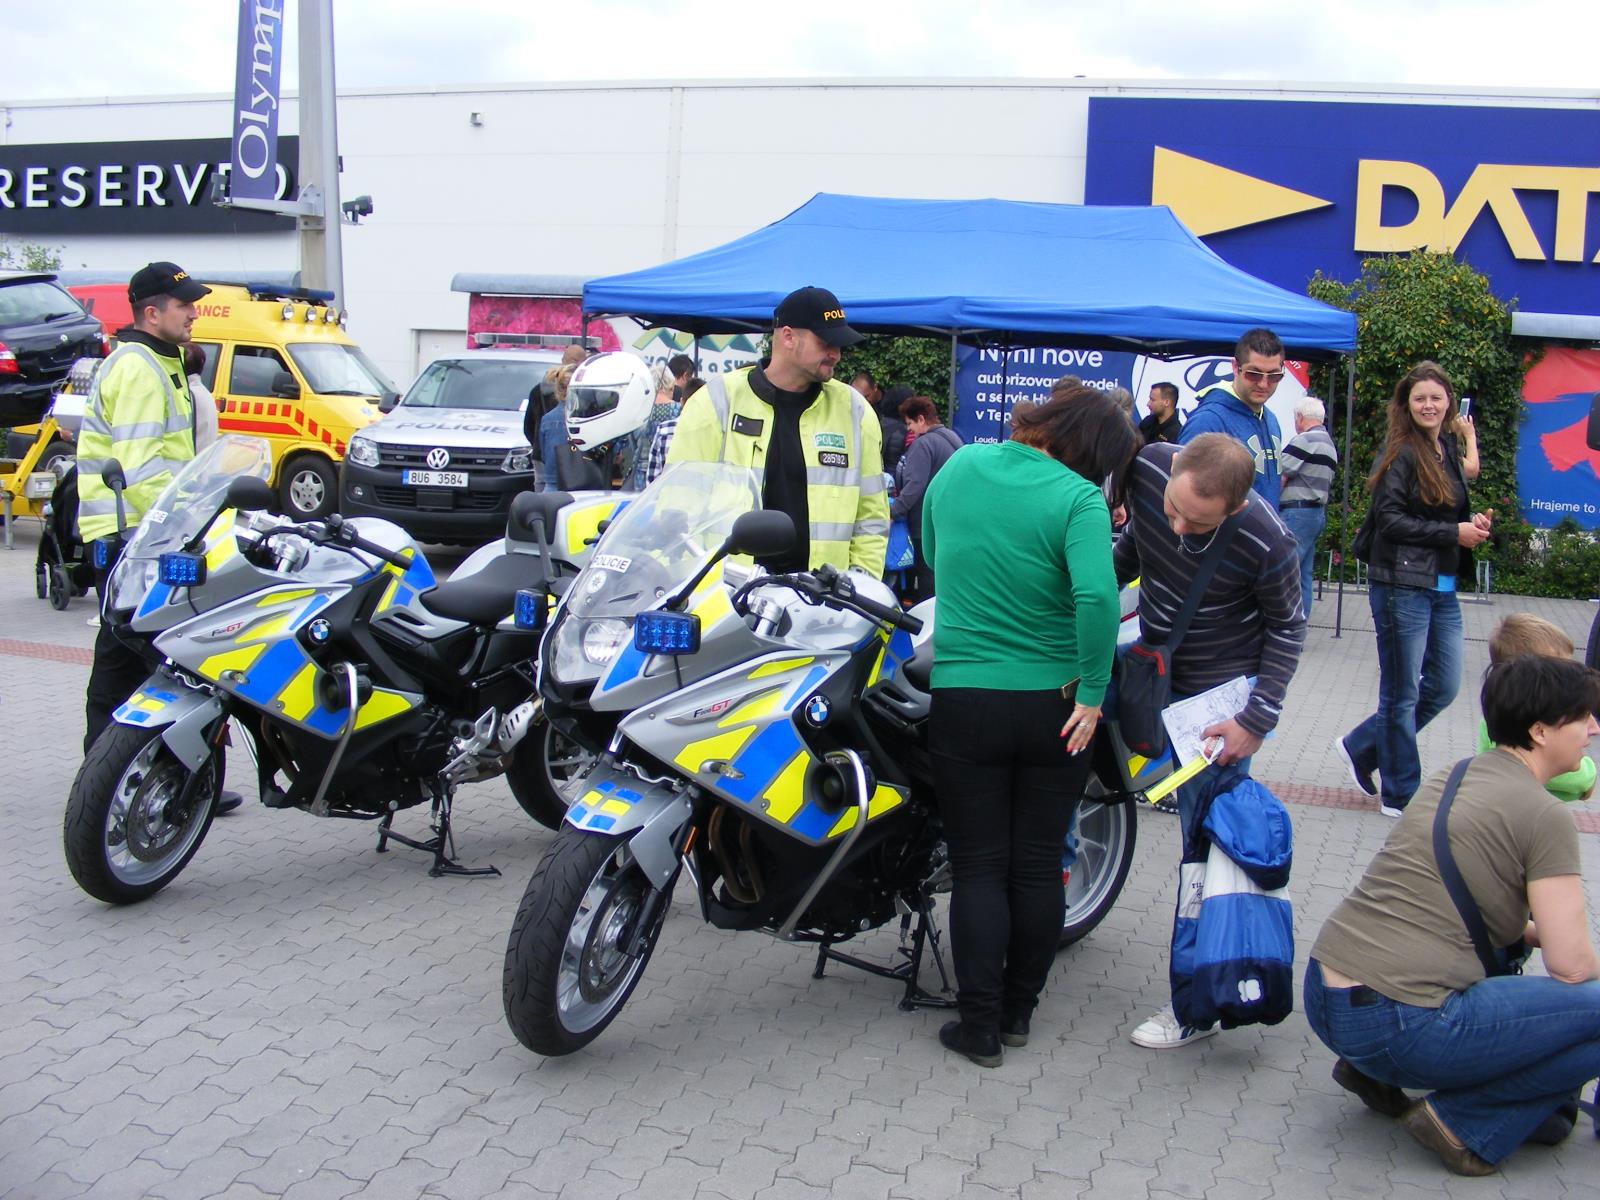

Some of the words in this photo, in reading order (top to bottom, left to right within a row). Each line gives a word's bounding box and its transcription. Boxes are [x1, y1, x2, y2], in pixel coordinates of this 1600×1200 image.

[1354, 159, 1600, 262] DAT
[976, 392, 986, 403] a
[975, 410, 985, 421] v
[396, 421, 511, 434] POLICIE
[411, 472, 430, 483] 8U6
[437, 473, 463, 485] 3584
[1531, 498, 1580, 513] Hrajeme
[1584, 503, 1596, 514] to
